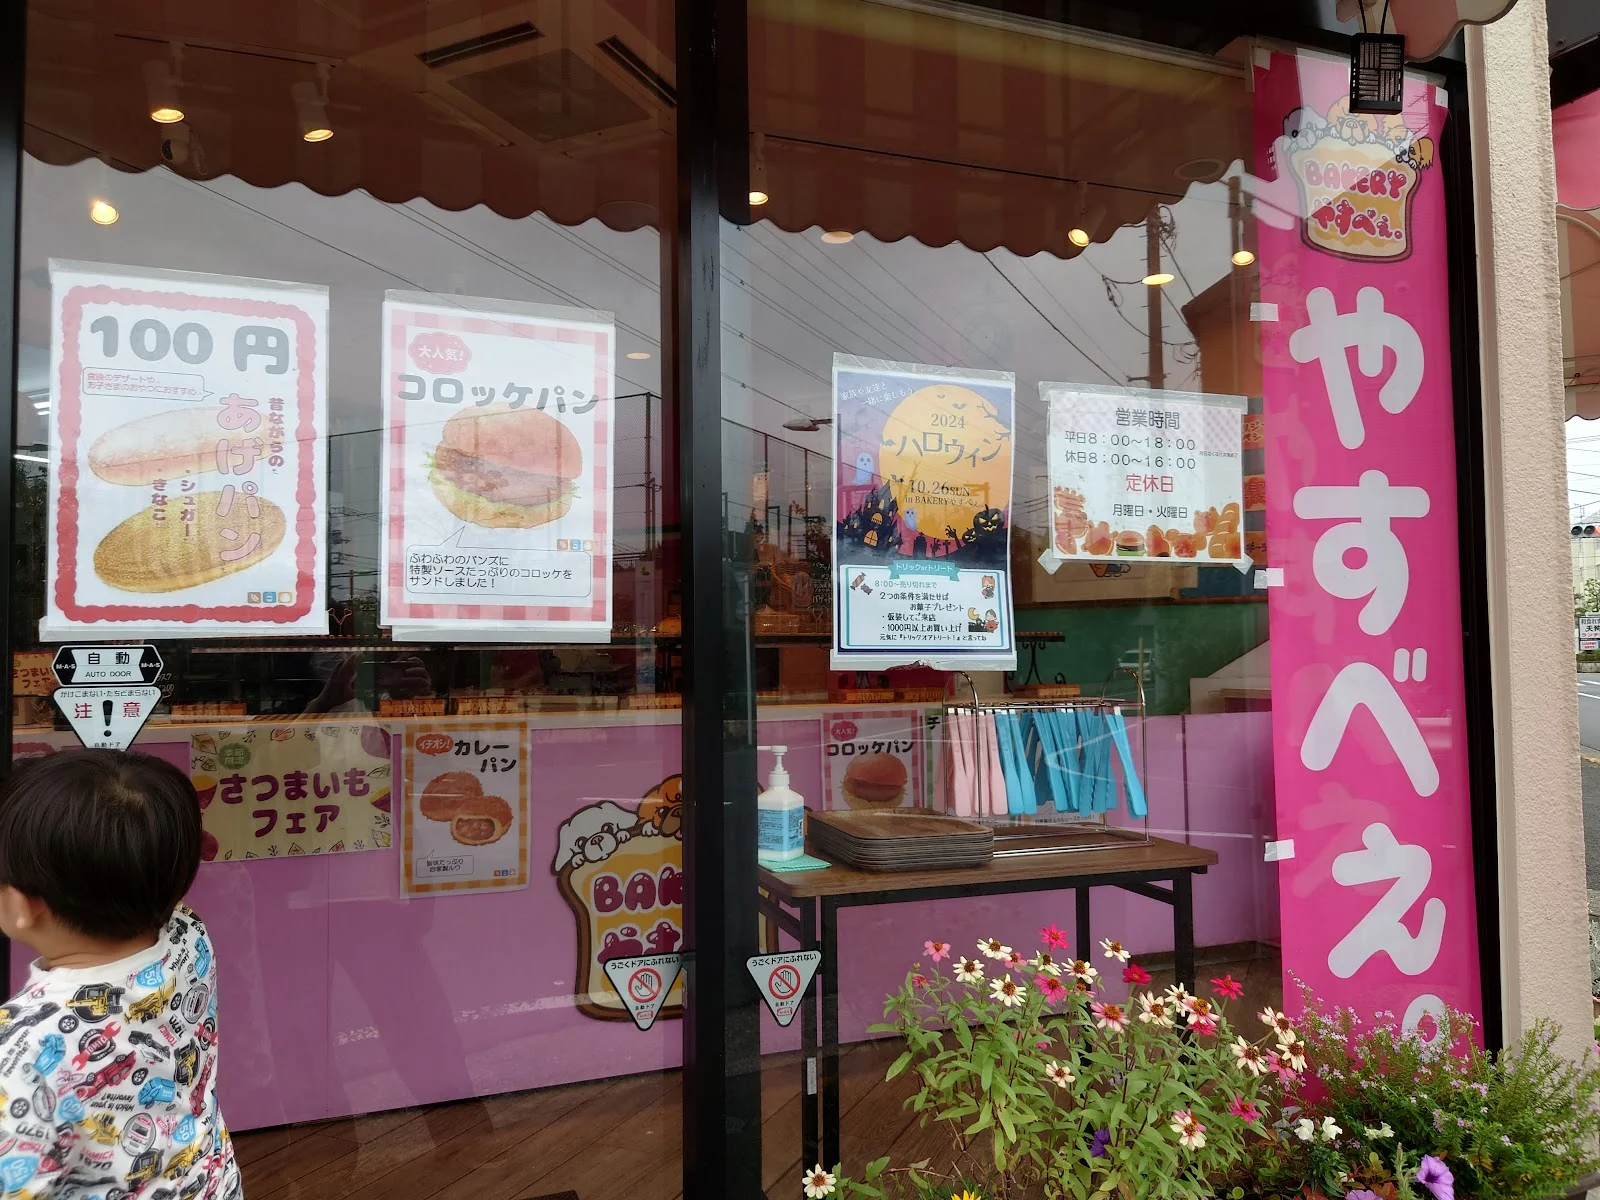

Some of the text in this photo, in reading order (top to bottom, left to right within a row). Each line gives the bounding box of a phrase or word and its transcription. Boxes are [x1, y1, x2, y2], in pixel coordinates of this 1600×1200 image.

[1305, 160, 1407, 199] BAKERY
[90, 315, 290, 375] 100 円
[398, 374, 600, 414] コロッケパン
[931, 414, 966, 428] 2024
[1115, 407, 1180, 430] 営業時間
[268, 397, 285, 467] 昔ながらの
[896, 431, 1002, 468] ハロウィン
[216, 393, 264, 561] あげパン
[1125, 474, 1174, 493] 定休日
[1112, 504, 1188, 519] 月曜日・火曜日
[409, 564, 573, 580] 特製ソースたっぷりのコロッケを
[896, 563, 953, 572] トリックorトリート
[909, 603, 964, 612] お菓子プレゼント
[13, 667, 52, 678] さつまい
[60, 690, 156, 698] かけこまない・たちどまらない
[454, 740, 510, 756] カレー
[827, 739, 914, 757] コロッケパン
[480, 757, 517, 773] パン
[220, 768, 370, 804] さつまいも
[252, 805, 340, 837] フェア
[610, 956, 680, 970] うごくドアにふれない
[751, 953, 817, 967] うごくドアにふれない
[13, 1028, 29, 1048] your
[157, 1023, 178, 1047] TOMICA
[89, 1100, 107, 1108] your
[101, 1092, 134, 1102] favorite?
[114, 1102, 135, 1111] Which
